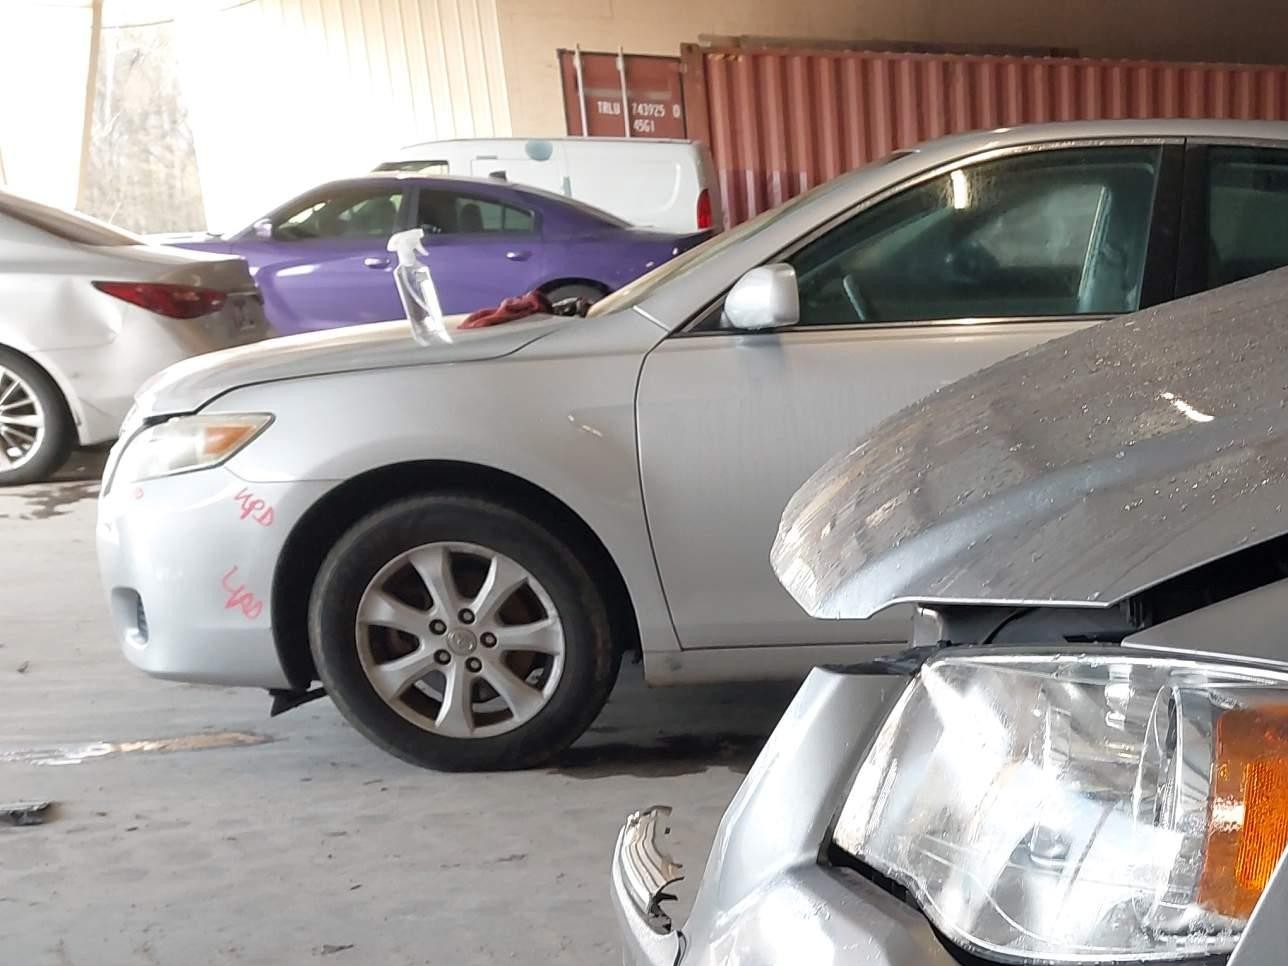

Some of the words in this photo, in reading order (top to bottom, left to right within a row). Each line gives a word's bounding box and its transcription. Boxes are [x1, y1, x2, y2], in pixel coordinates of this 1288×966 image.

[597, 101, 621, 115] TRLU
[631, 102, 666, 117] 743925
[672, 104, 681, 118] 0
